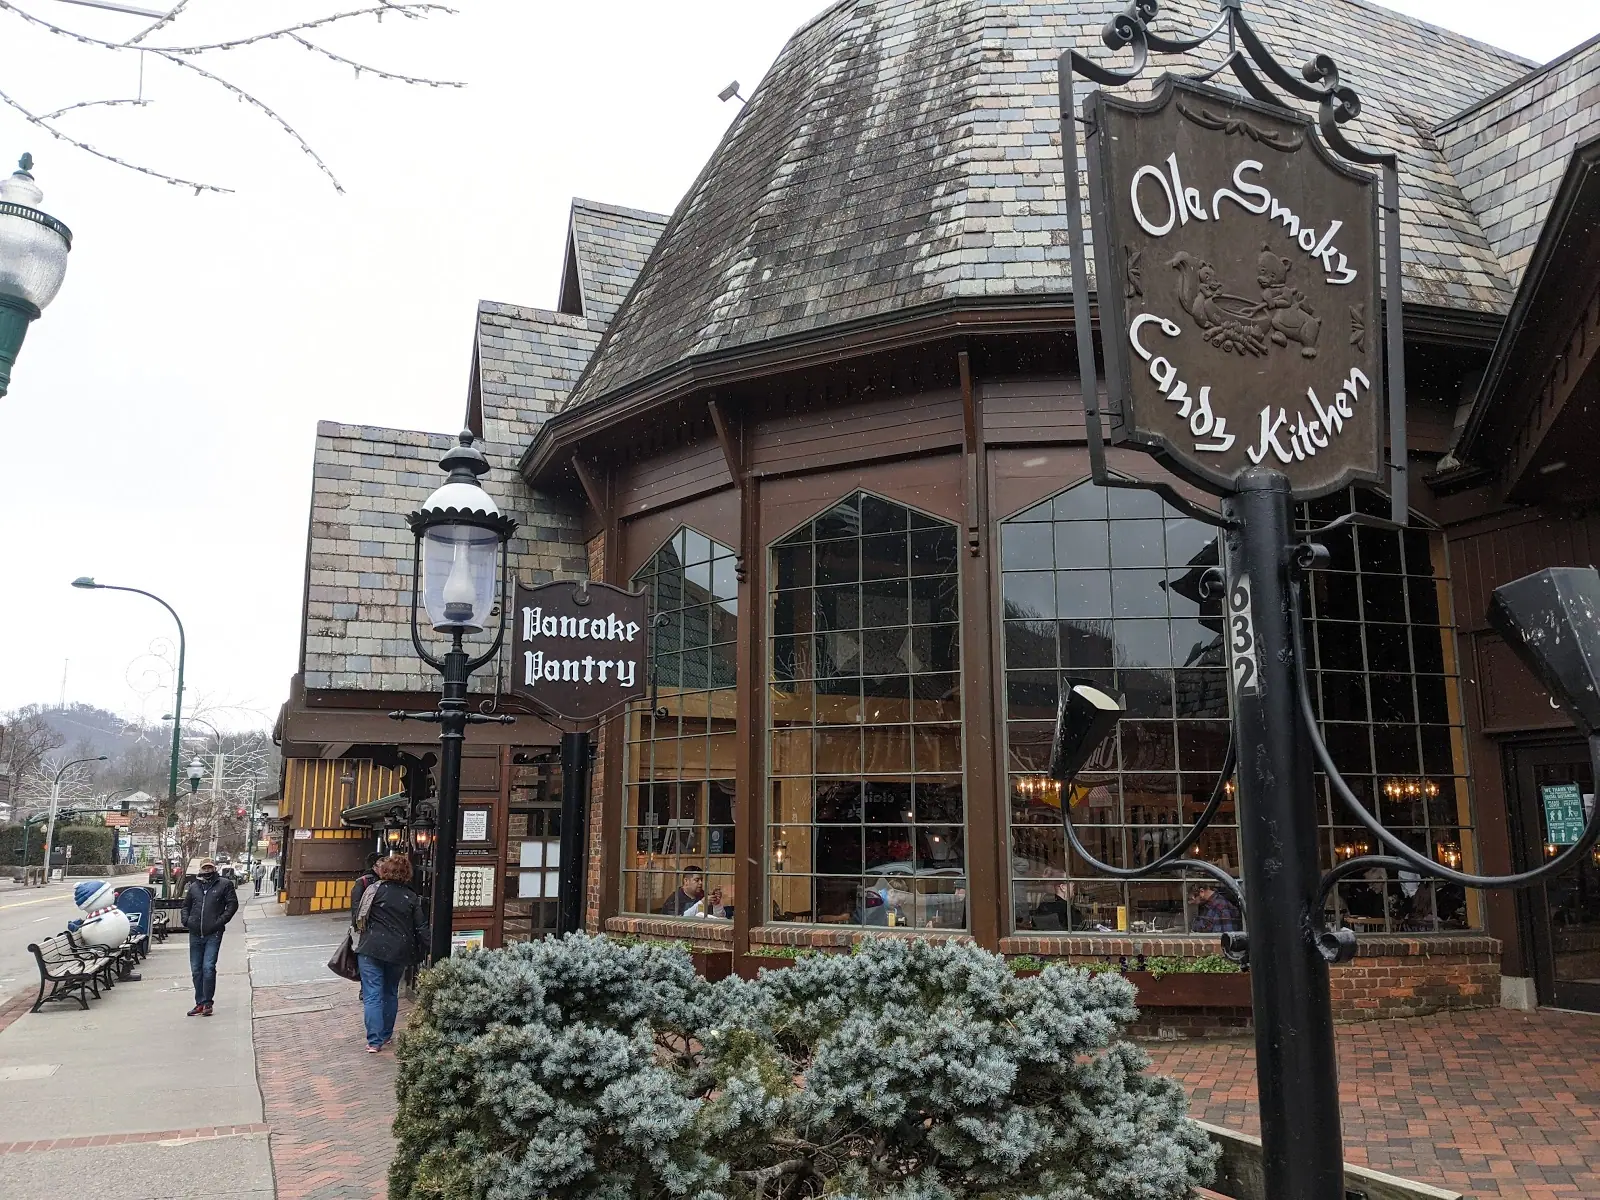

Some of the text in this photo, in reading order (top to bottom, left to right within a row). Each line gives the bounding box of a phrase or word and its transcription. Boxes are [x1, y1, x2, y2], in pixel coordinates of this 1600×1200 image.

[1130, 152, 1358, 285] Ole Smoky
[1129, 313, 1371, 464] Candy Kitchen
[521, 607, 641, 642] Pancake
[523, 650, 637, 687] Pantry
[1230, 573, 1256, 698] 632
